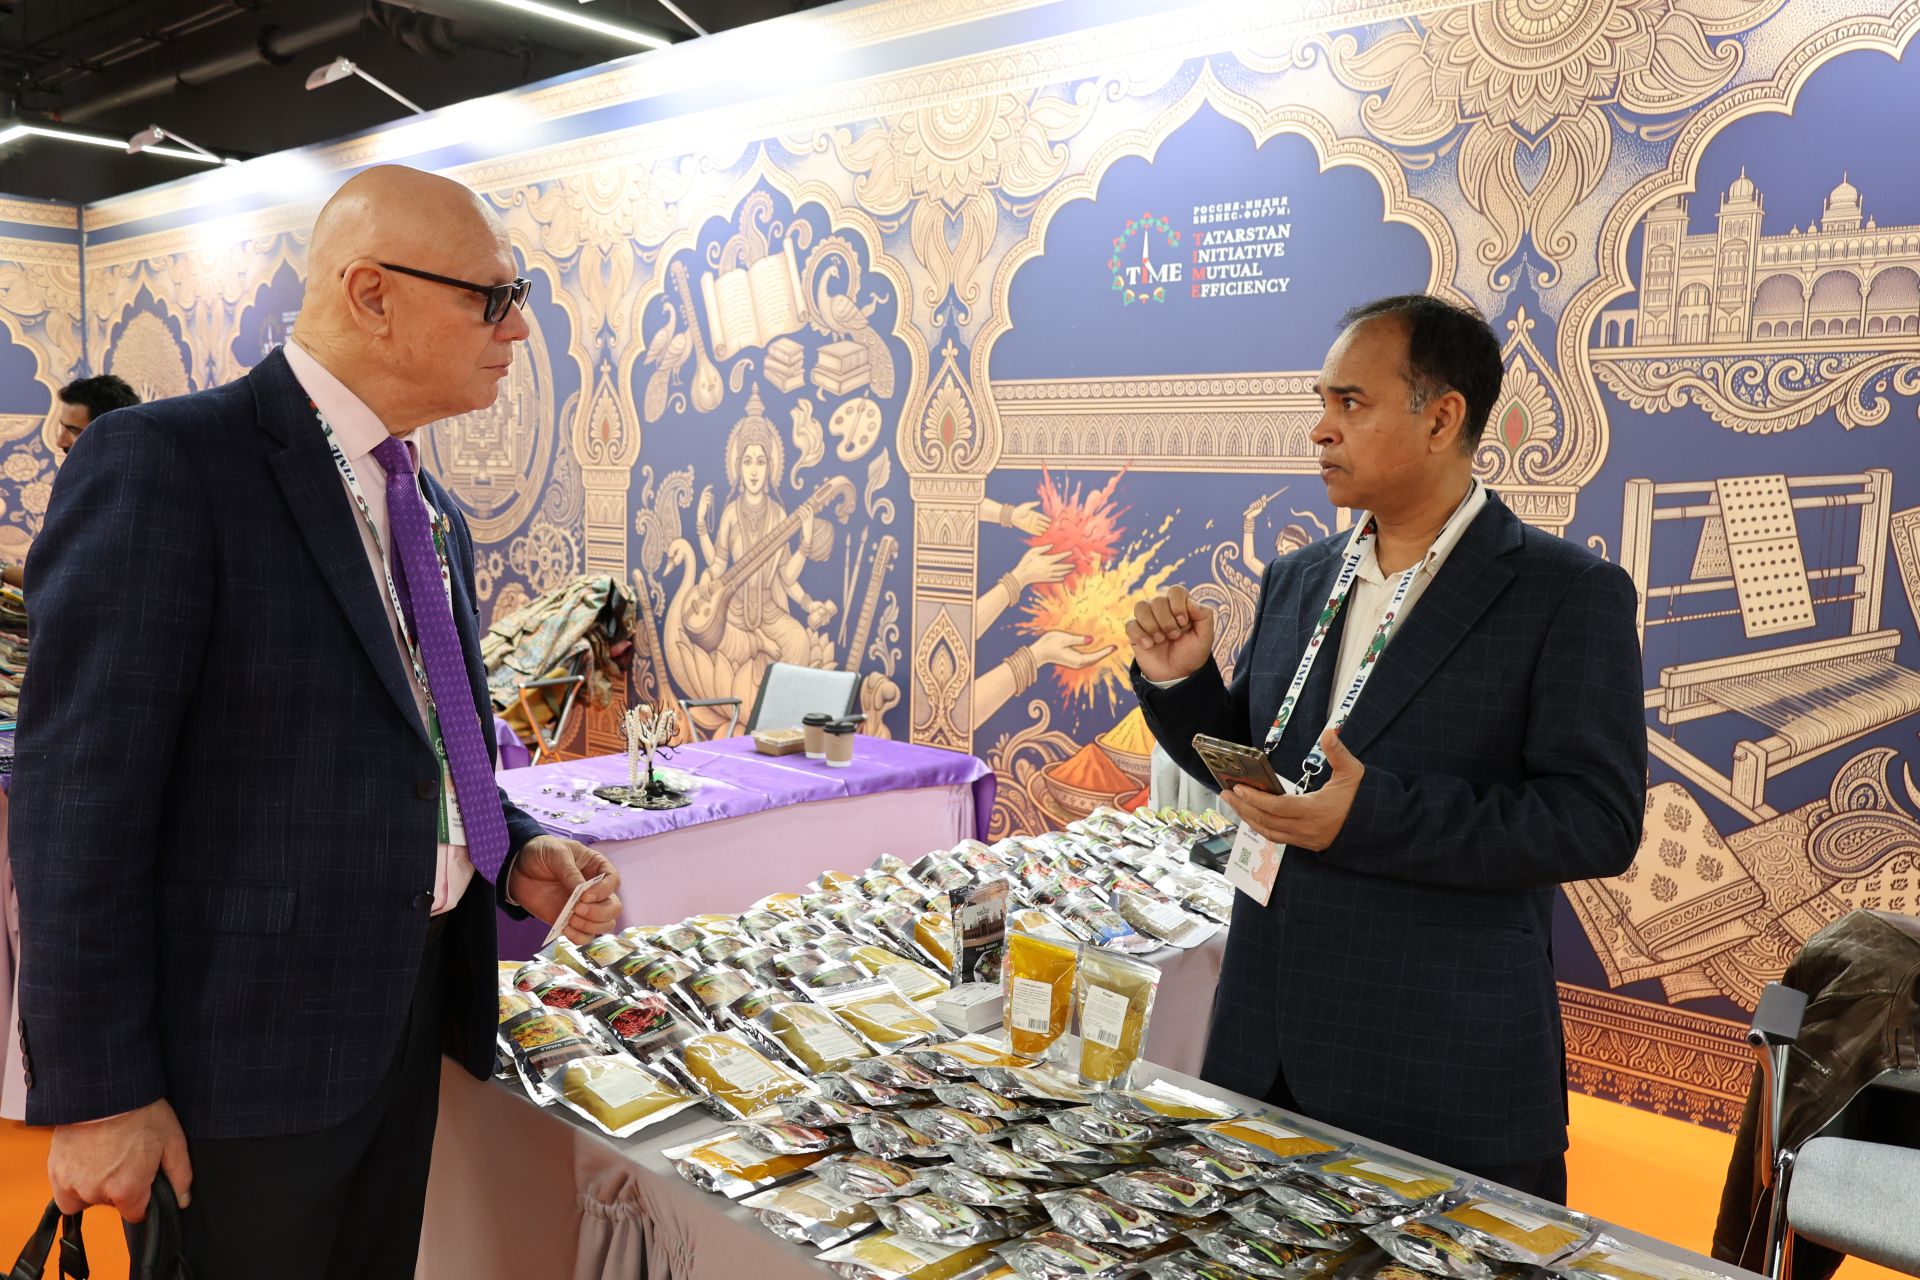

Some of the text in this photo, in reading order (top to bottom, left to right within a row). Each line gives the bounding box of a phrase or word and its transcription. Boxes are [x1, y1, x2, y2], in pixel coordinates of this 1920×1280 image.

[1193, 223, 1291, 246] TATARSTAN
[1192, 242, 1285, 264] INITIATIVE
[1126, 263, 1182, 286] TIME
[1192, 262, 1263, 280] MUTUAL
[1191, 277, 1290, 298] EFFICIENCY
[331, 444, 355, 485] TIME
[1338, 554, 1361, 587] TIME
[1293, 654, 1313, 690] TIME
[1341, 675, 1366, 710] TIME
